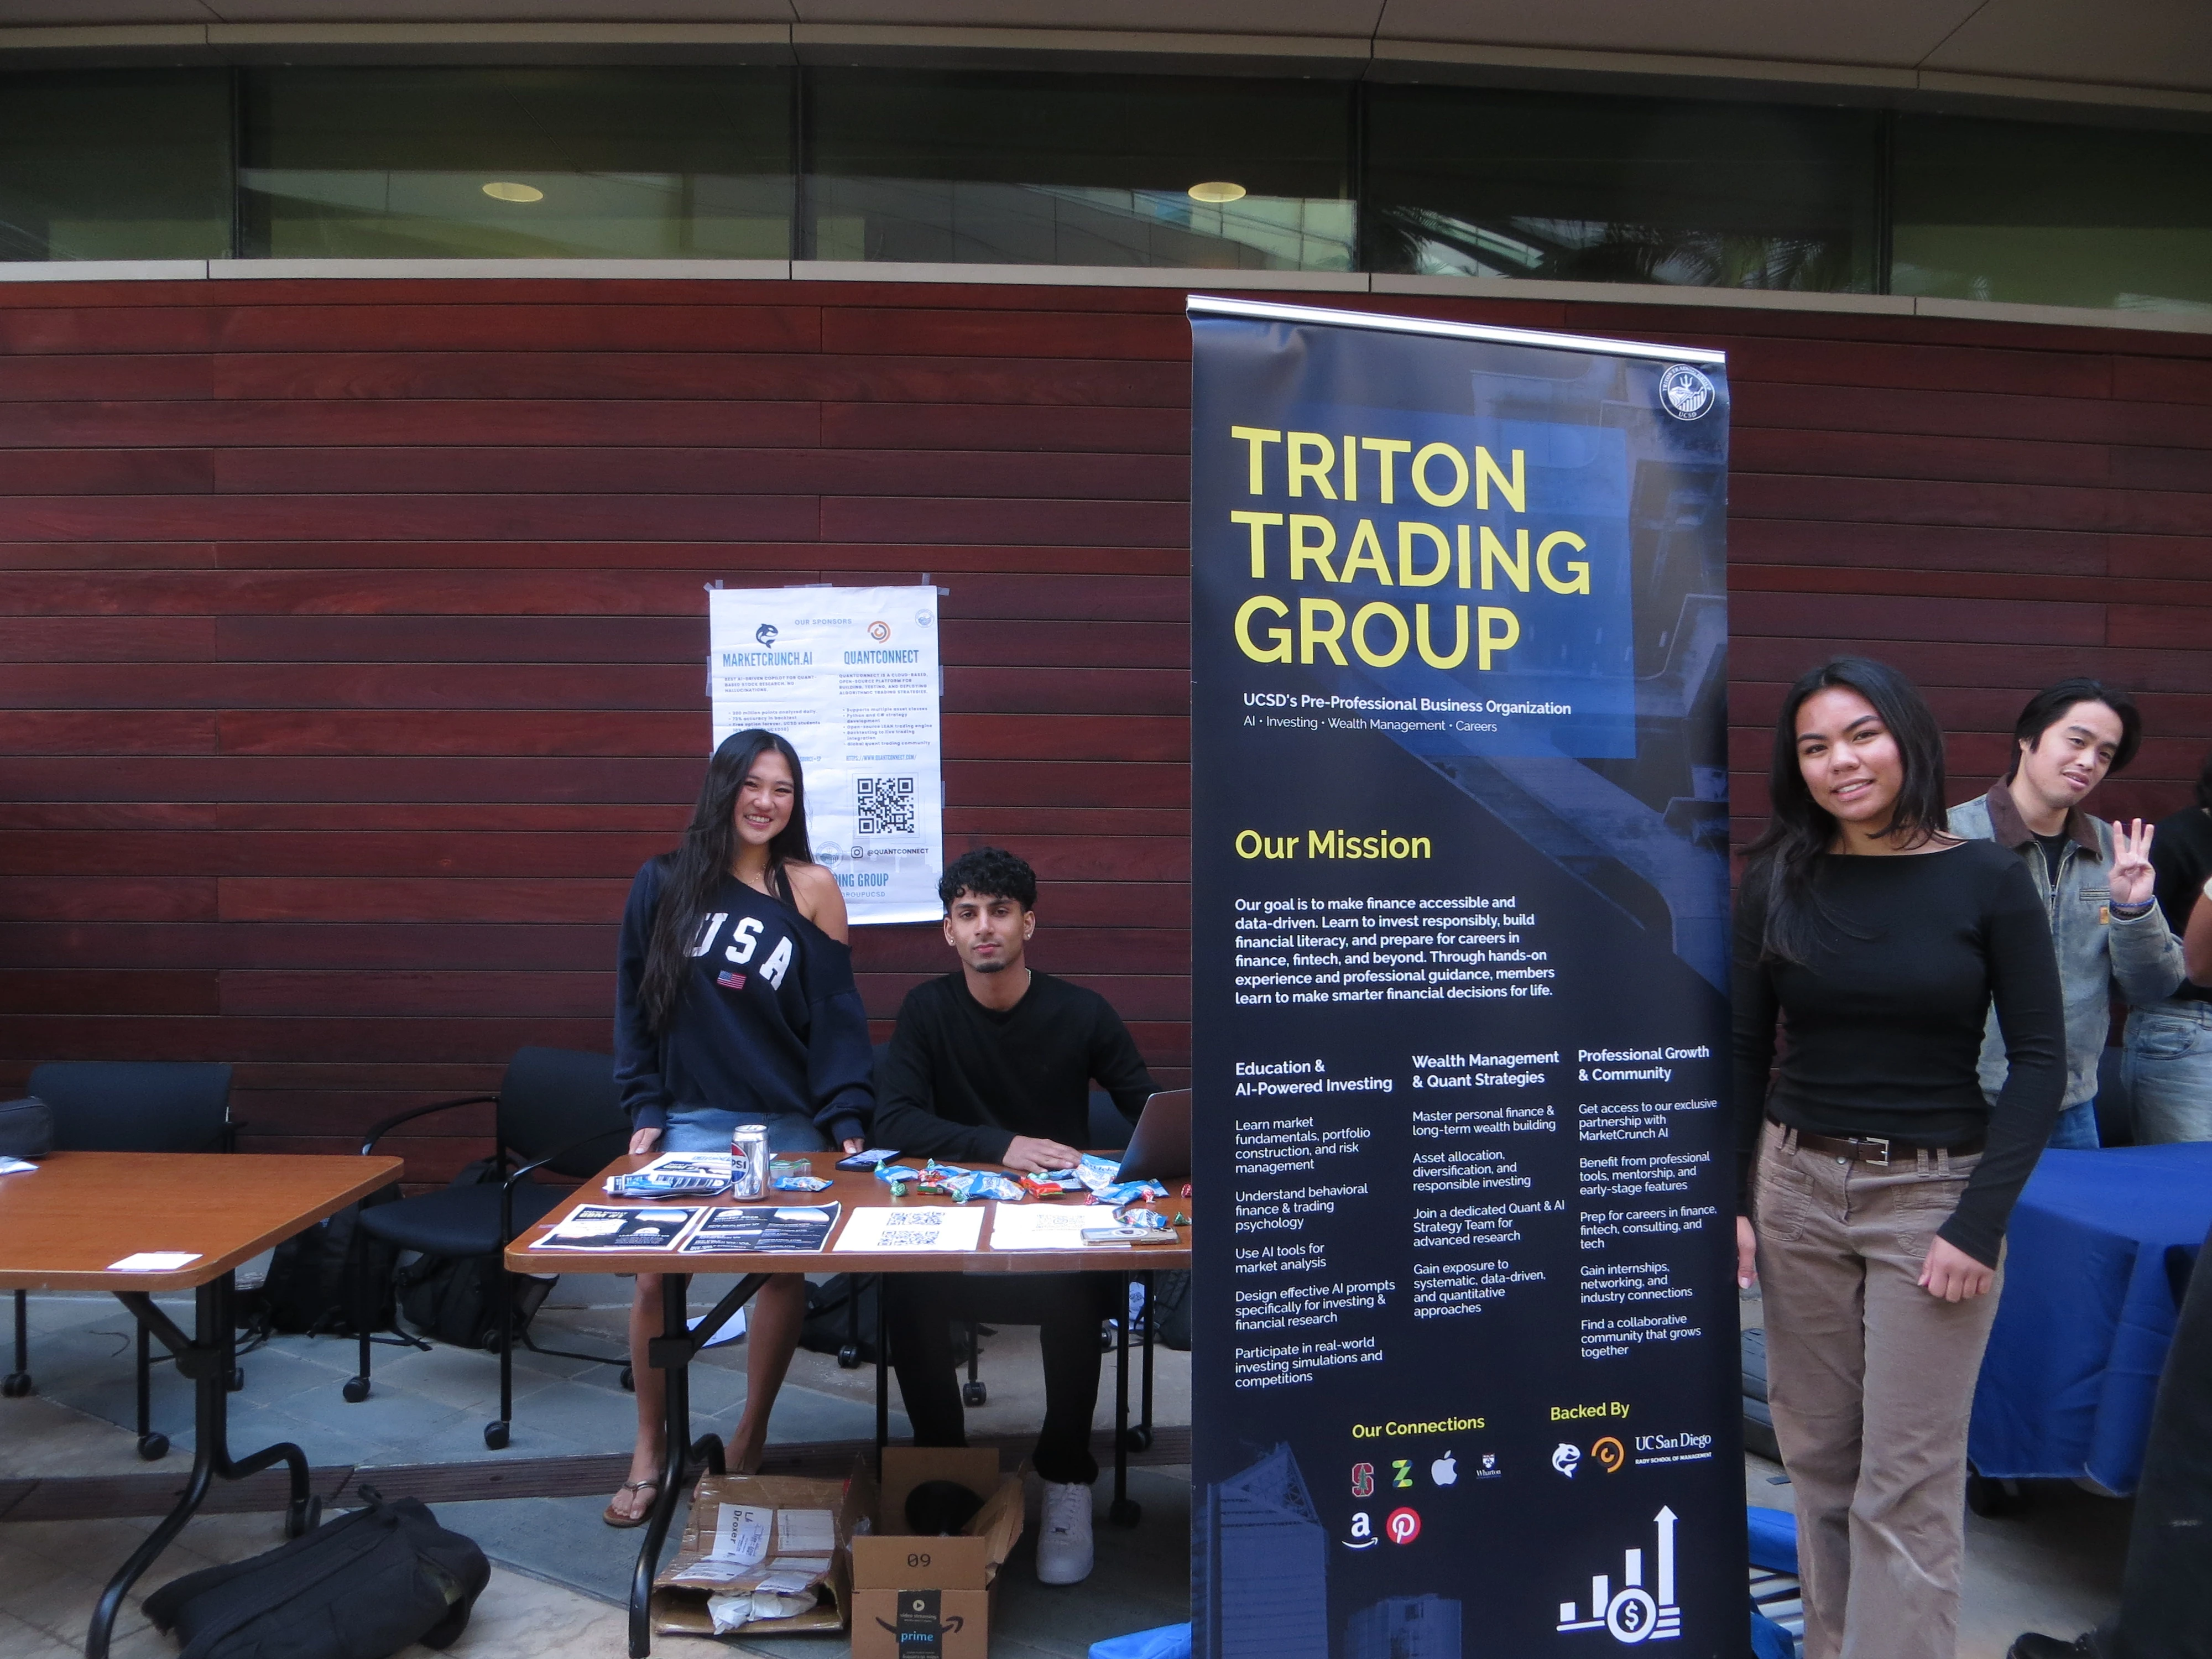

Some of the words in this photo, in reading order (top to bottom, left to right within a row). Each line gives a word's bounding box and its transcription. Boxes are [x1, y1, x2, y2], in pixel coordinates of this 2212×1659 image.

[1232, 426, 1525, 513] TRITON
[1231, 511, 1589, 594] TRADING
[1235, 596, 1520, 670] GROUP
[723, 652, 812, 666] MARKETCRUNCH.AI
[844, 650, 919, 664] QUANTCONNECT
[1244, 693, 1297, 707] UCSD's
[1302, 695, 1418, 710] Pre-Professional
[1421, 698, 1483, 712] Business
[1486, 700, 1571, 716] Organization
[1244, 716, 1255, 726] AI
[1267, 716, 1317, 730] Investing
[1328, 718, 1366, 729] Wealth
[1370, 719, 1446, 732] Management
[1456, 721, 1498, 732] Careers
[1236, 830, 1298, 858] Our
[1309, 830, 1430, 858] Mission
[858, 873, 889, 886] GROUP
[1235, 899, 1261, 910] Our
[1264, 898, 1295, 914] goal
[1298, 898, 1307, 910] is
[1311, 899, 1324, 910] to
[1328, 898, 1364, 909] make
[1367, 897, 1416, 909] finance
[1419, 896, 1489, 908] accessible
[1492, 896, 1515, 907] and
[1235, 917, 1318, 929] data-driven.
[1322, 917, 1358, 928] Learn
[1362, 916, 1375, 927] to
[1379, 915, 1419, 927] invest
[1423, 914, 1500, 929] responsibly,
[1504, 914, 1535, 925] build
[1412, 1054, 1465, 1068] Wealth
[1469, 1051, 1559, 1068] Management
[1579, 1047, 1663, 1062] Professional
[1665, 1045, 1709, 1059] Growth
[1237, 1061, 1311, 1075] Education
[1315, 1060, 1325, 1072] &
[1579, 1069, 1589, 1081] &
[1593, 1066, 1671, 1082] Community
[1235, 1079, 1322, 1095] AI-Powered
[1327, 1077, 1392, 1092] Investing
[1412, 1075, 1423, 1088] &
[1427, 1074, 1472, 1087] Quant
[1475, 1071, 1545, 1087] Strategies
[1579, 1104, 1598, 1114] Get
[1601, 1105, 1639, 1113] access
[1641, 1102, 1652, 1112] to
[1674, 1099, 1717, 1110] exclusive
[1413, 1208, 1437, 1219] Join
[1450, 1204, 1506, 1217] dedicated
[1509, 1202, 1541, 1213] Quant
[1544, 1201, 1552, 1211] &
[1554, 1200, 1564, 1210] AI
[1236, 1249, 1259, 1259] Use
[1262, 1246, 1273, 1257] AI
[1277, 1244, 1305, 1256] tools
[1309, 1243, 1324, 1253] for
[1582, 1345, 1629, 1359] together
[1551, 1402, 1606, 1420] Backed
[1611, 1402, 1629, 1418] By
[1353, 1425, 1381, 1438] Our
[1386, 1417, 1484, 1435] Connections
[1636, 1436, 1654, 1450] UC
[1656, 1435, 1678, 1449] San
[1680, 1433, 1711, 1448] Diego
[907, 1553, 931, 1567] 09
[901, 1631, 934, 1642] prime
